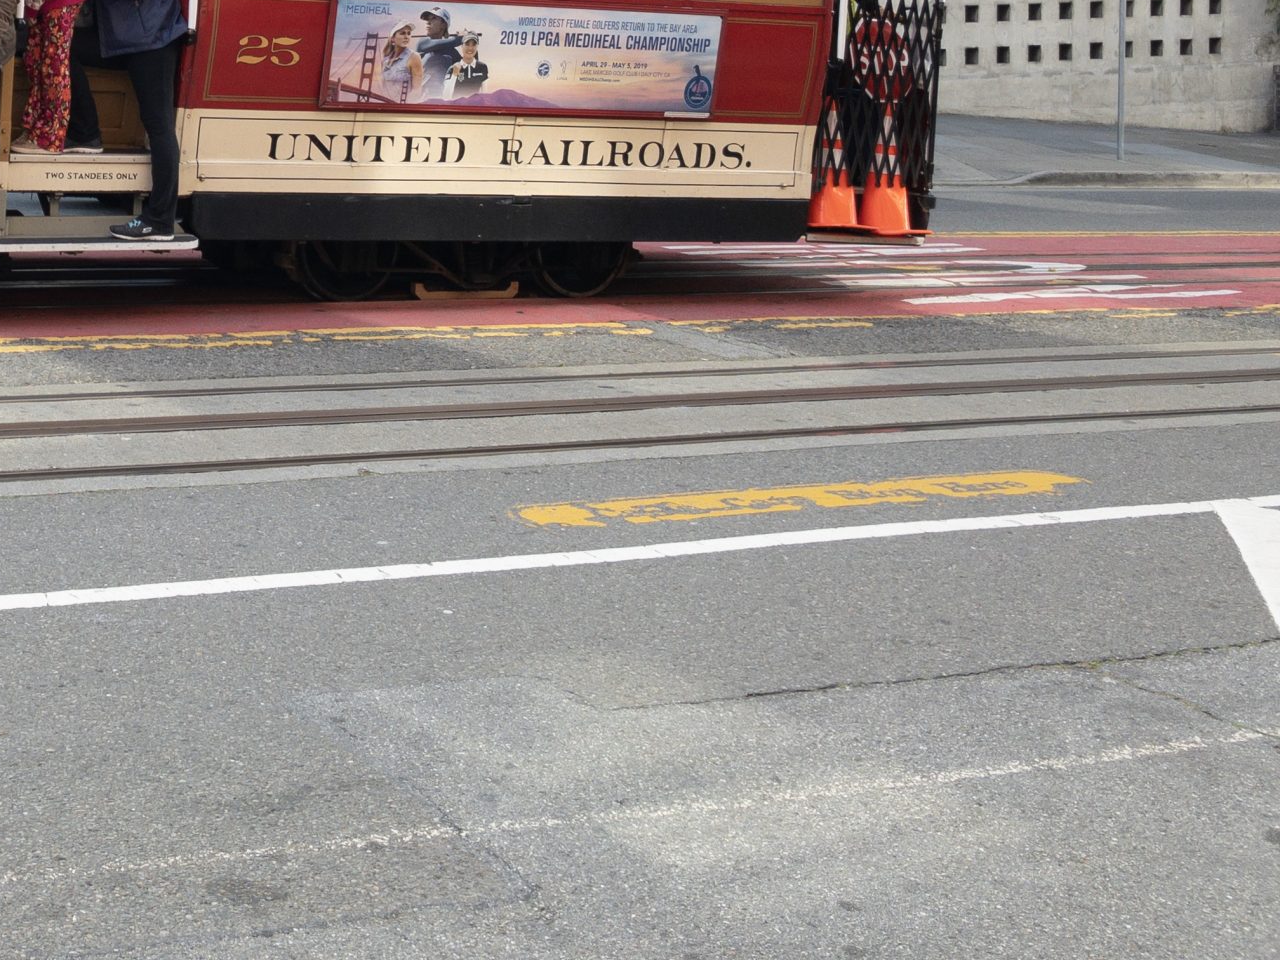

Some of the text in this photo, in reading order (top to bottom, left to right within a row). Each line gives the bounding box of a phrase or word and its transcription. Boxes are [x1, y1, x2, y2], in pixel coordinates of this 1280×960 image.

[346, 5, 392, 15] MEDIHEAL
[519, 17, 698, 34] WORLD'S BEST FEMALE GOLFERS RETURN TO THE BAY AREA
[500, 30, 711, 53] 2019 LPGA MEDIHEAL CHAMPIONSHIP
[236, 35, 302, 66] 25
[581, 60, 598, 68] APRIL
[268, 132, 752, 169] UNITED RAILROADS.
[67, 172, 113, 180] STANDEES
[116, 172, 138, 180] ONLY
